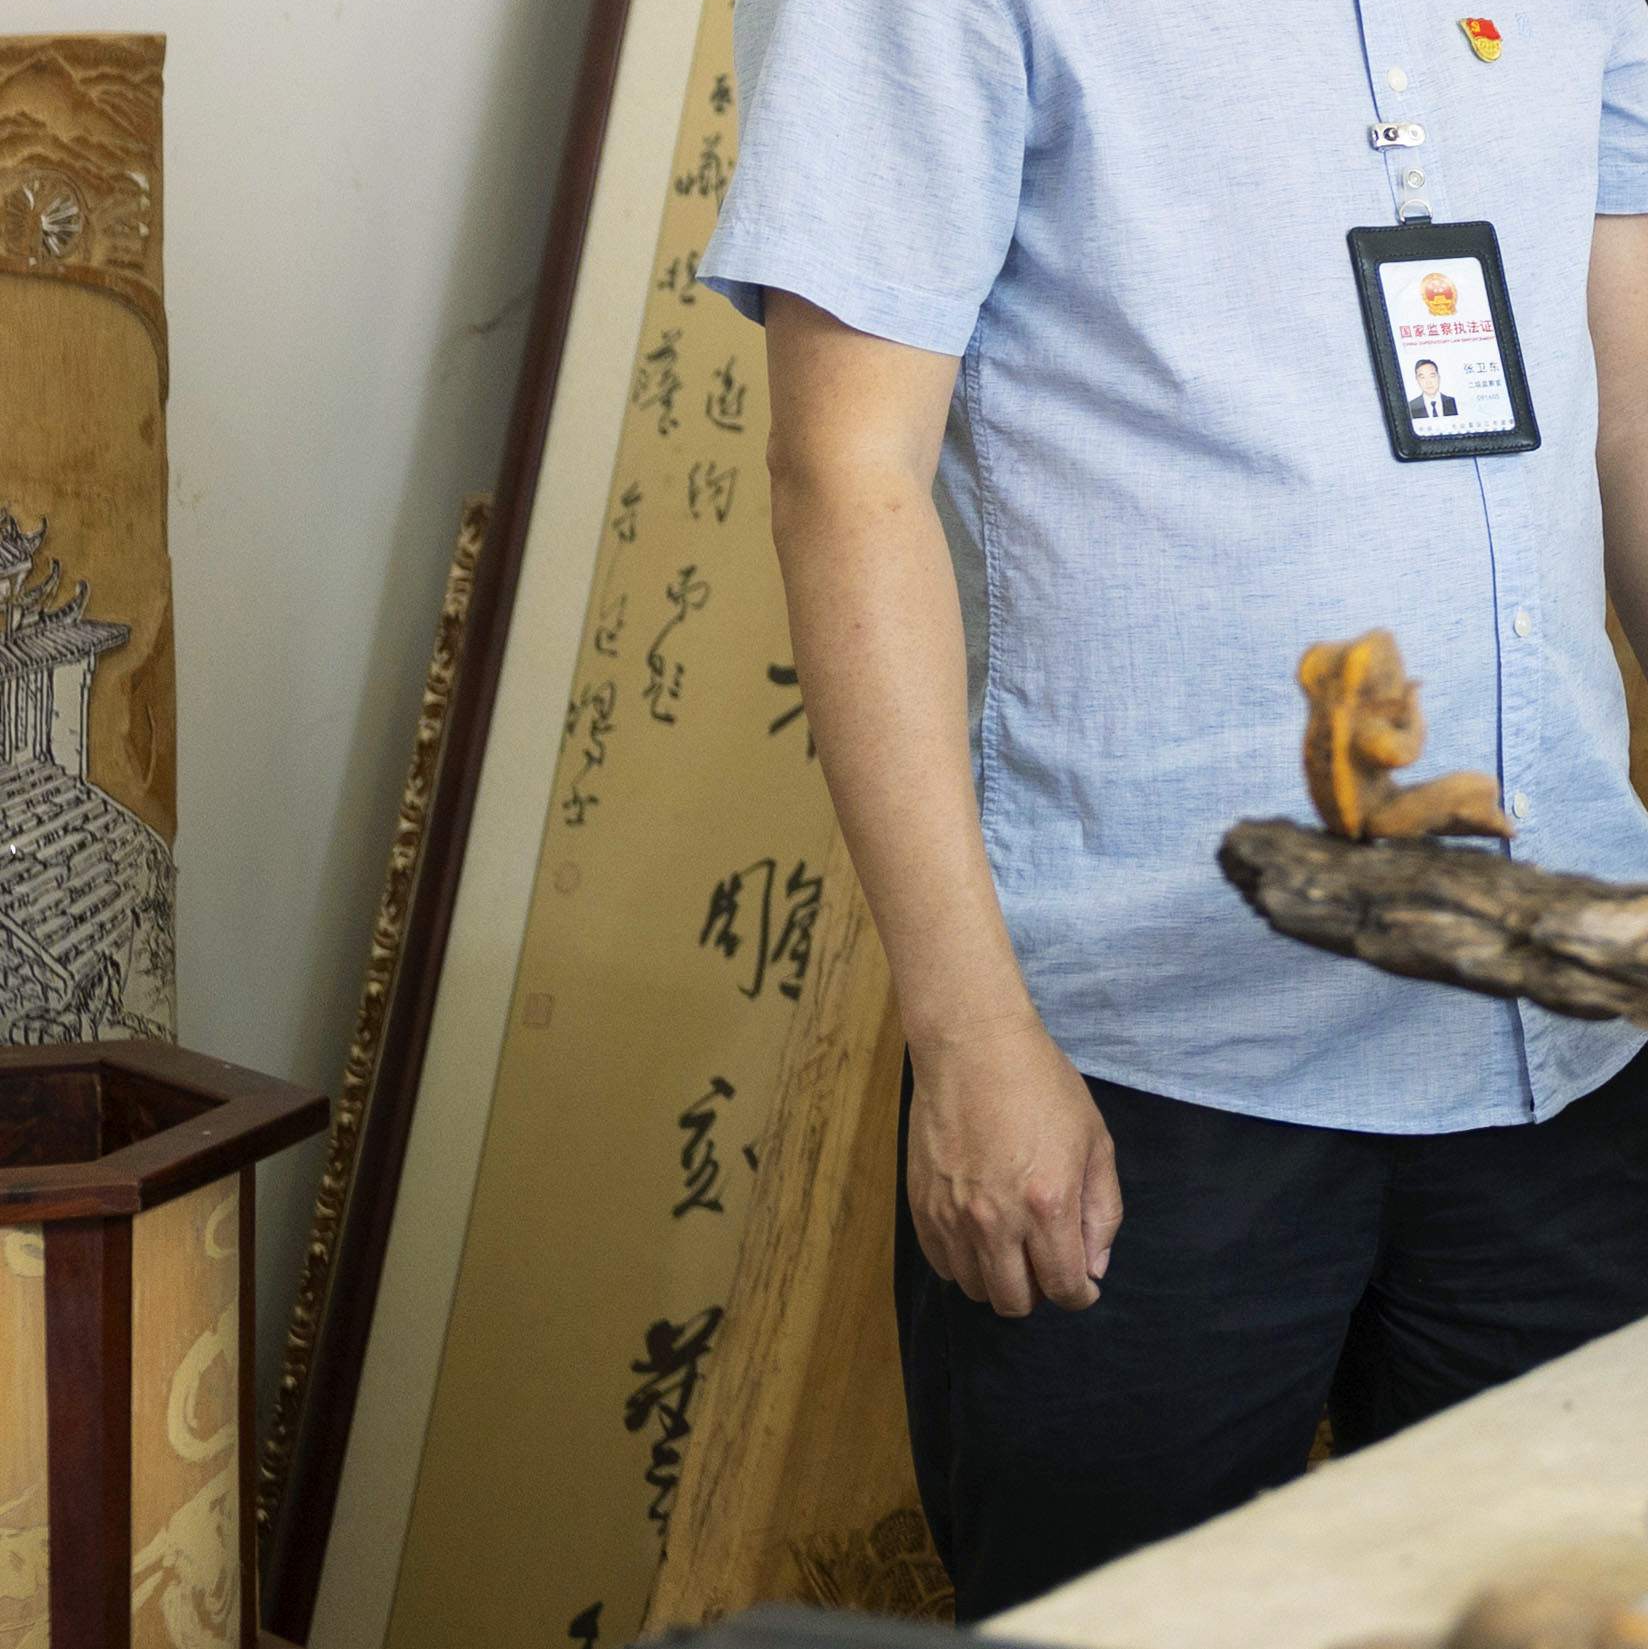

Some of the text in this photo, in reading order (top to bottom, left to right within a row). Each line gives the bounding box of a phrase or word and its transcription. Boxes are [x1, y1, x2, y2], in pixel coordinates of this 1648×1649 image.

[1400, 320, 1494, 337] 国家监察执法证
